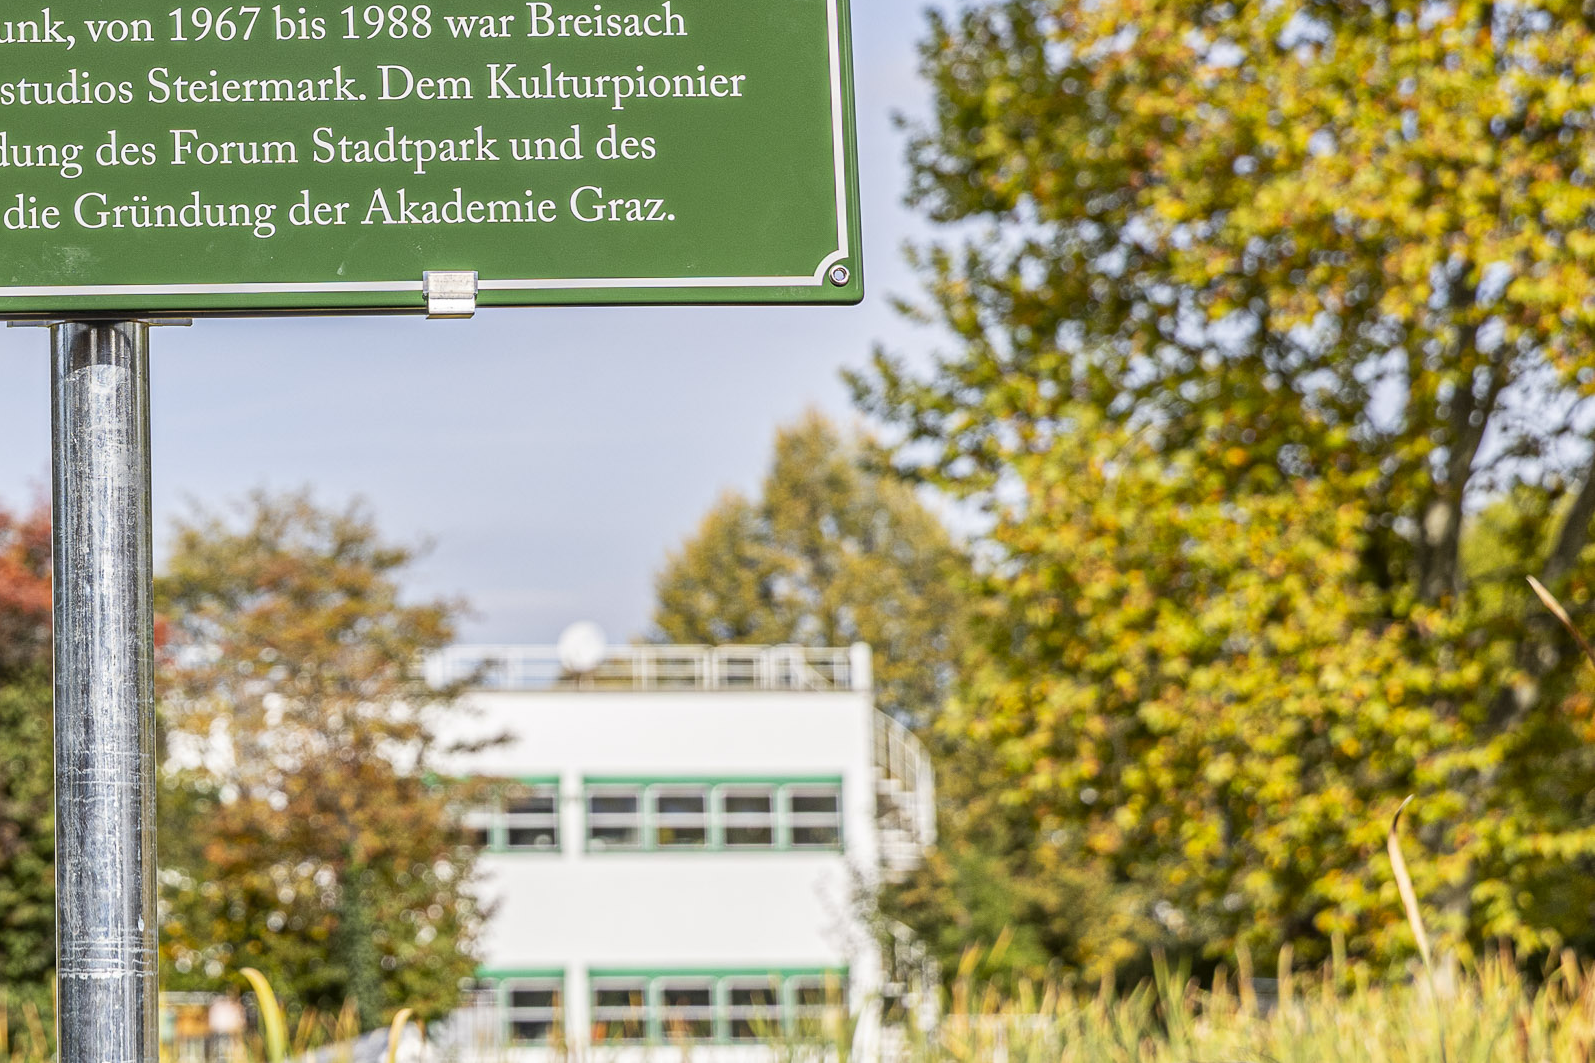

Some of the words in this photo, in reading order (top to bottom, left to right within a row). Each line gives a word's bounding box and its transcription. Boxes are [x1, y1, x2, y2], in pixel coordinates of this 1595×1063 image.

[83, 19, 155, 43] von
[168, 5, 261, 42] 1967
[271, 4, 326, 41] bis
[340, 4, 432, 40] 1988
[443, 15, 515, 39] war
[525, 0, 688, 37] Breisach
[147, 65, 367, 104] Steiermark.
[376, 64, 474, 100] Dem
[486, 62, 747, 111] Kulturpionier
[95, 129, 157, 166] des
[169, 129, 299, 165] Forum
[312, 125, 501, 175] Stadtpark
[508, 124, 585, 161] und
[595, 123, 656, 160] des
[3, 193, 61, 230] die
[73, 190, 277, 239] Gründung
[288, 189, 350, 226] der
[360, 187, 557, 225] Akademie
[569, 185, 676, 222] Graz.
